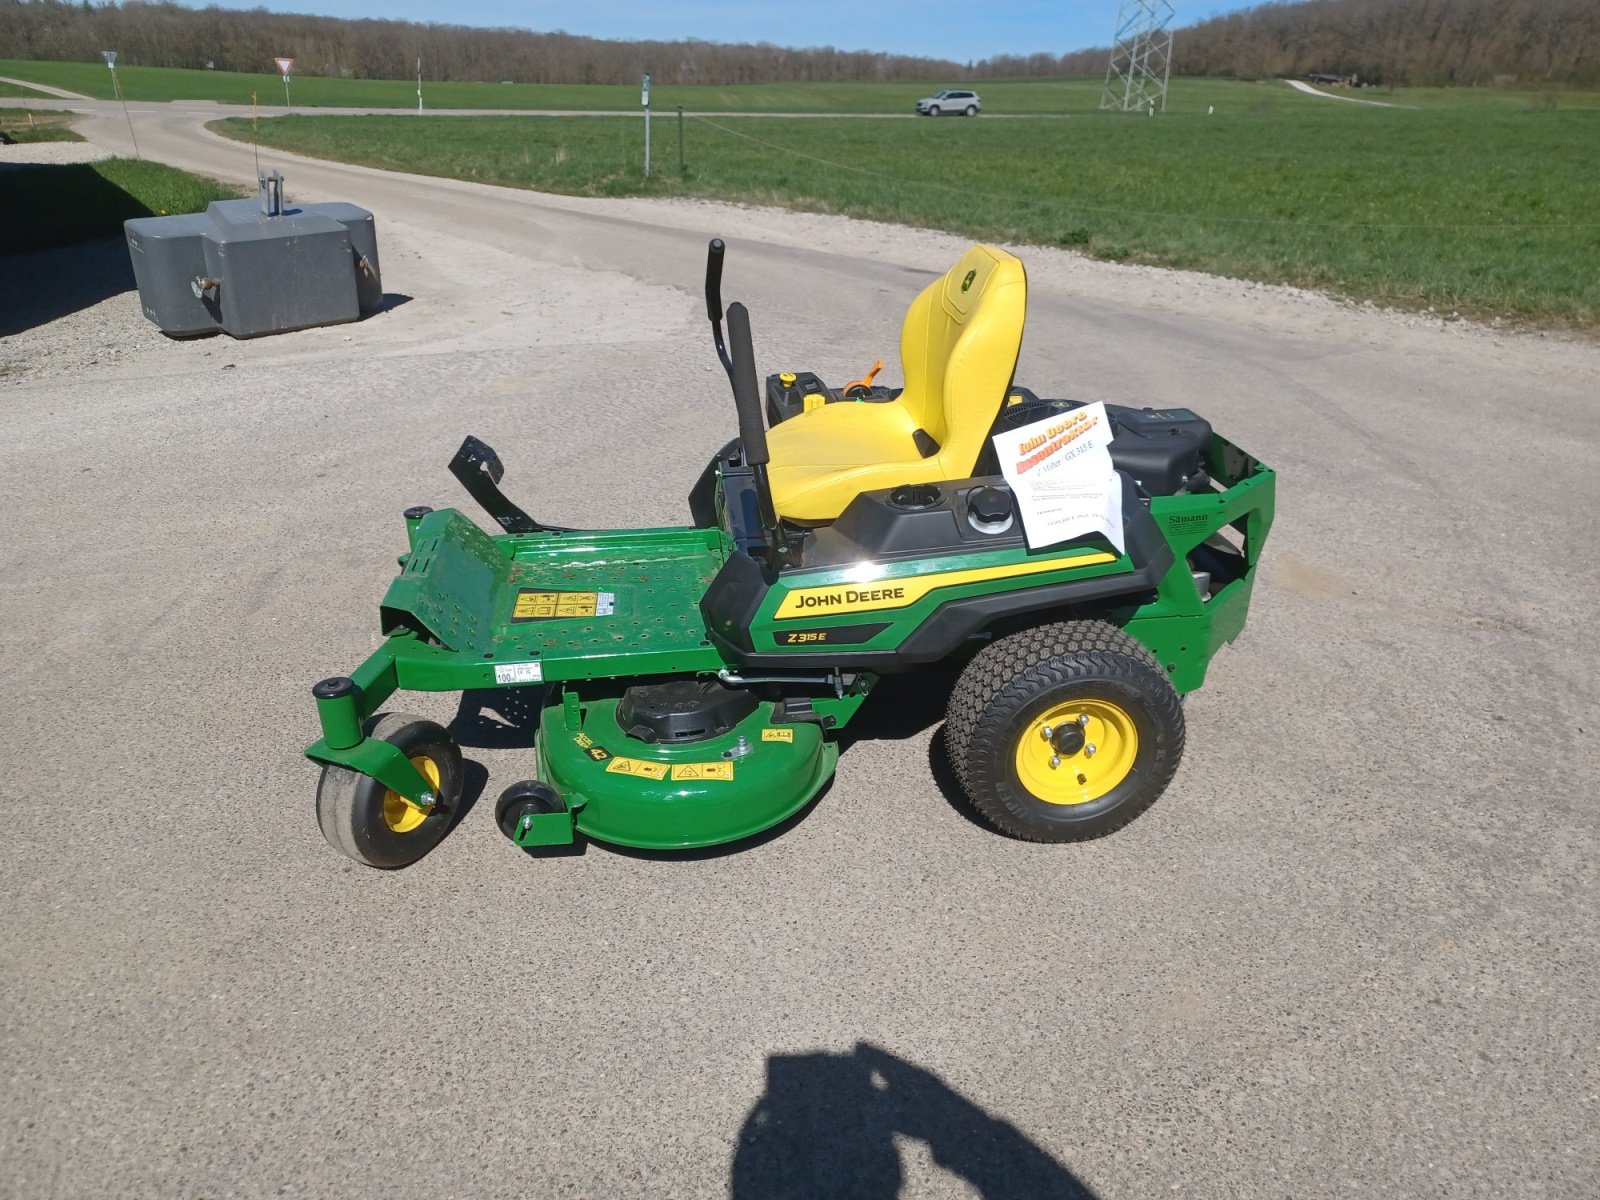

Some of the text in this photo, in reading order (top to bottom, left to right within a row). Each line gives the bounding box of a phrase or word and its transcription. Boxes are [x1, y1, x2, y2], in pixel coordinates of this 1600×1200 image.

[1018, 411, 1087, 455] John Deere
[1169, 514, 1207, 522] Sämann
[795, 587, 905, 609] JOHN DEERE
[497, 673, 511, 682] 100
[590, 748, 607, 760] 42
